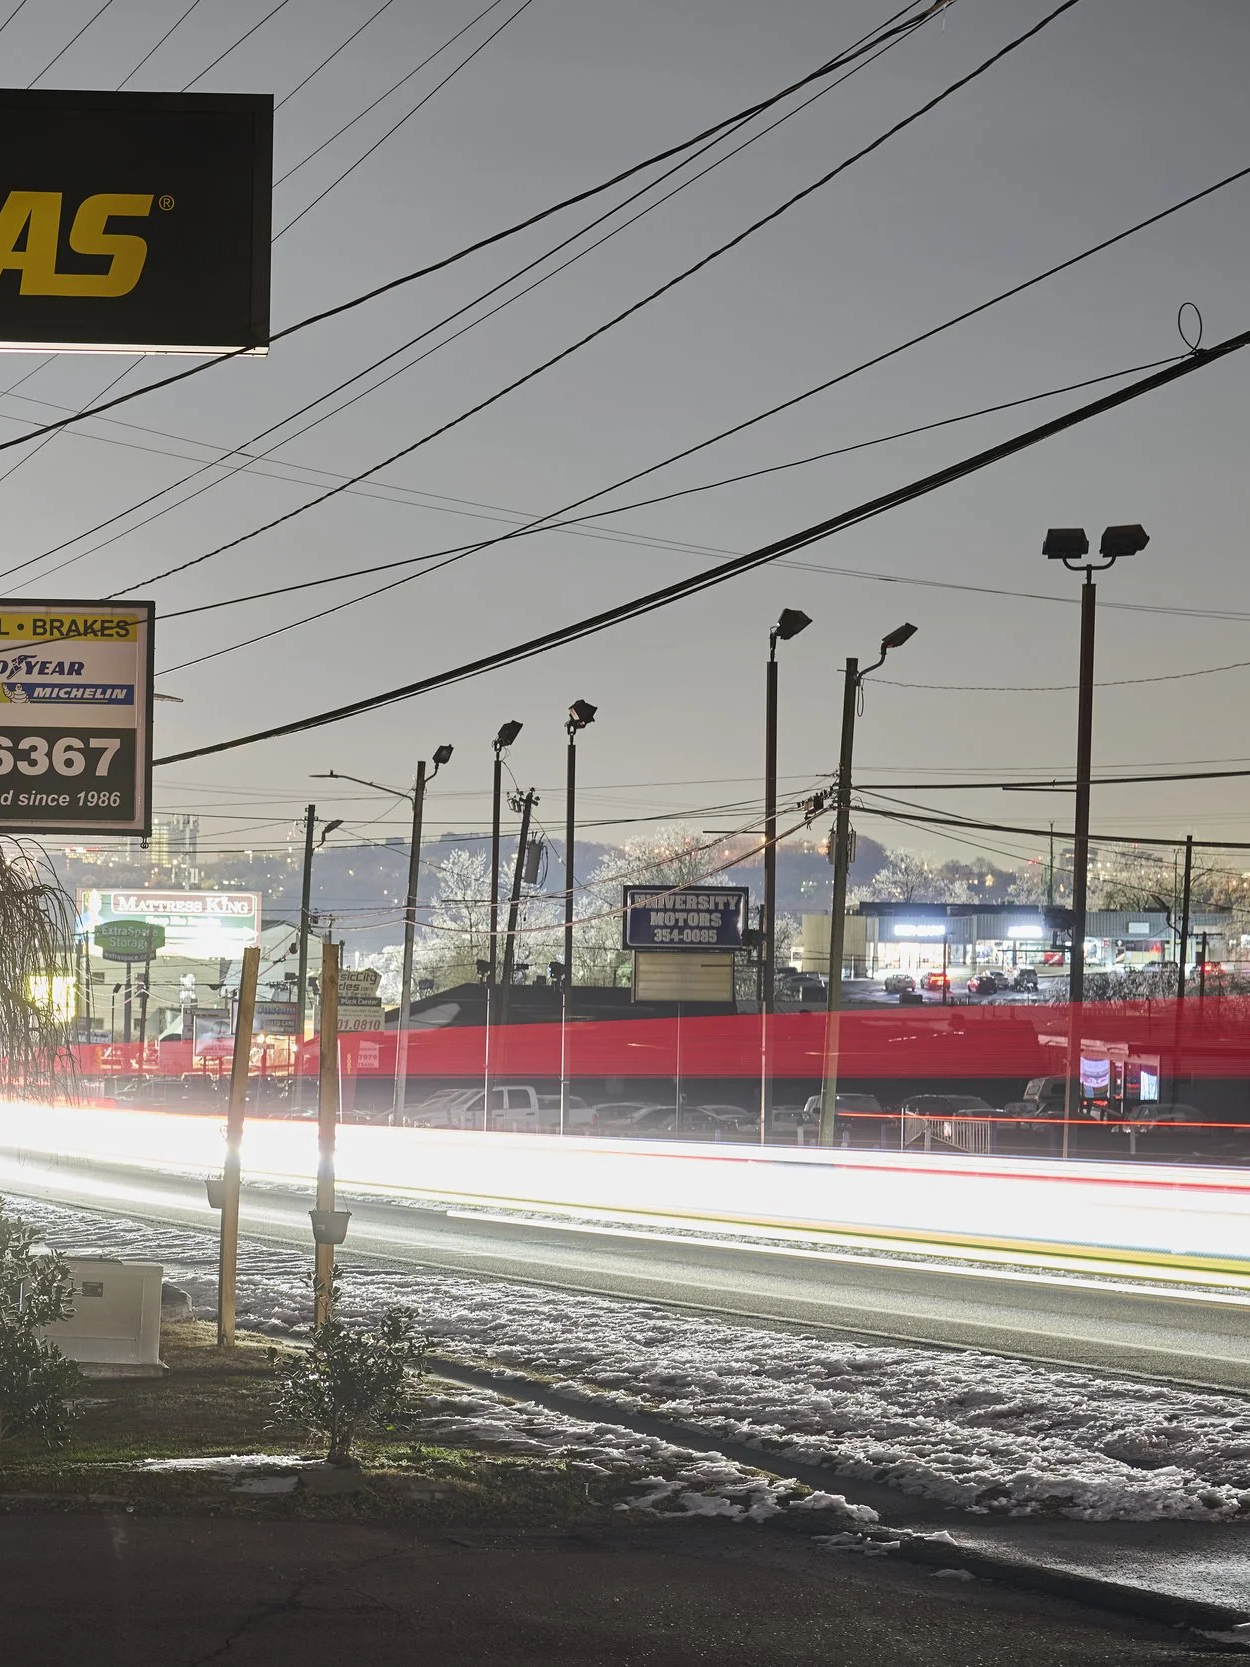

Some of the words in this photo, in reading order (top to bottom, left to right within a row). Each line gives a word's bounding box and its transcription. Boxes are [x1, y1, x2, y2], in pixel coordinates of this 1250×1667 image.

[31, 618, 130, 638] BRAKES
[32, 686, 128, 701] MICHELIN
[17, 790, 70, 807] since
[76, 791, 121, 808] 1986
[117, 896, 203, 913] MATTRESS
[205, 896, 249, 914] KING
[634, 894, 738, 910] UNIVERSITY
[650, 911, 722, 928] MOTORS
[101, 926, 158, 938] ExtraSpae
[654, 929, 718, 943] 354-0085
[339, 972, 378, 985] sicCity
